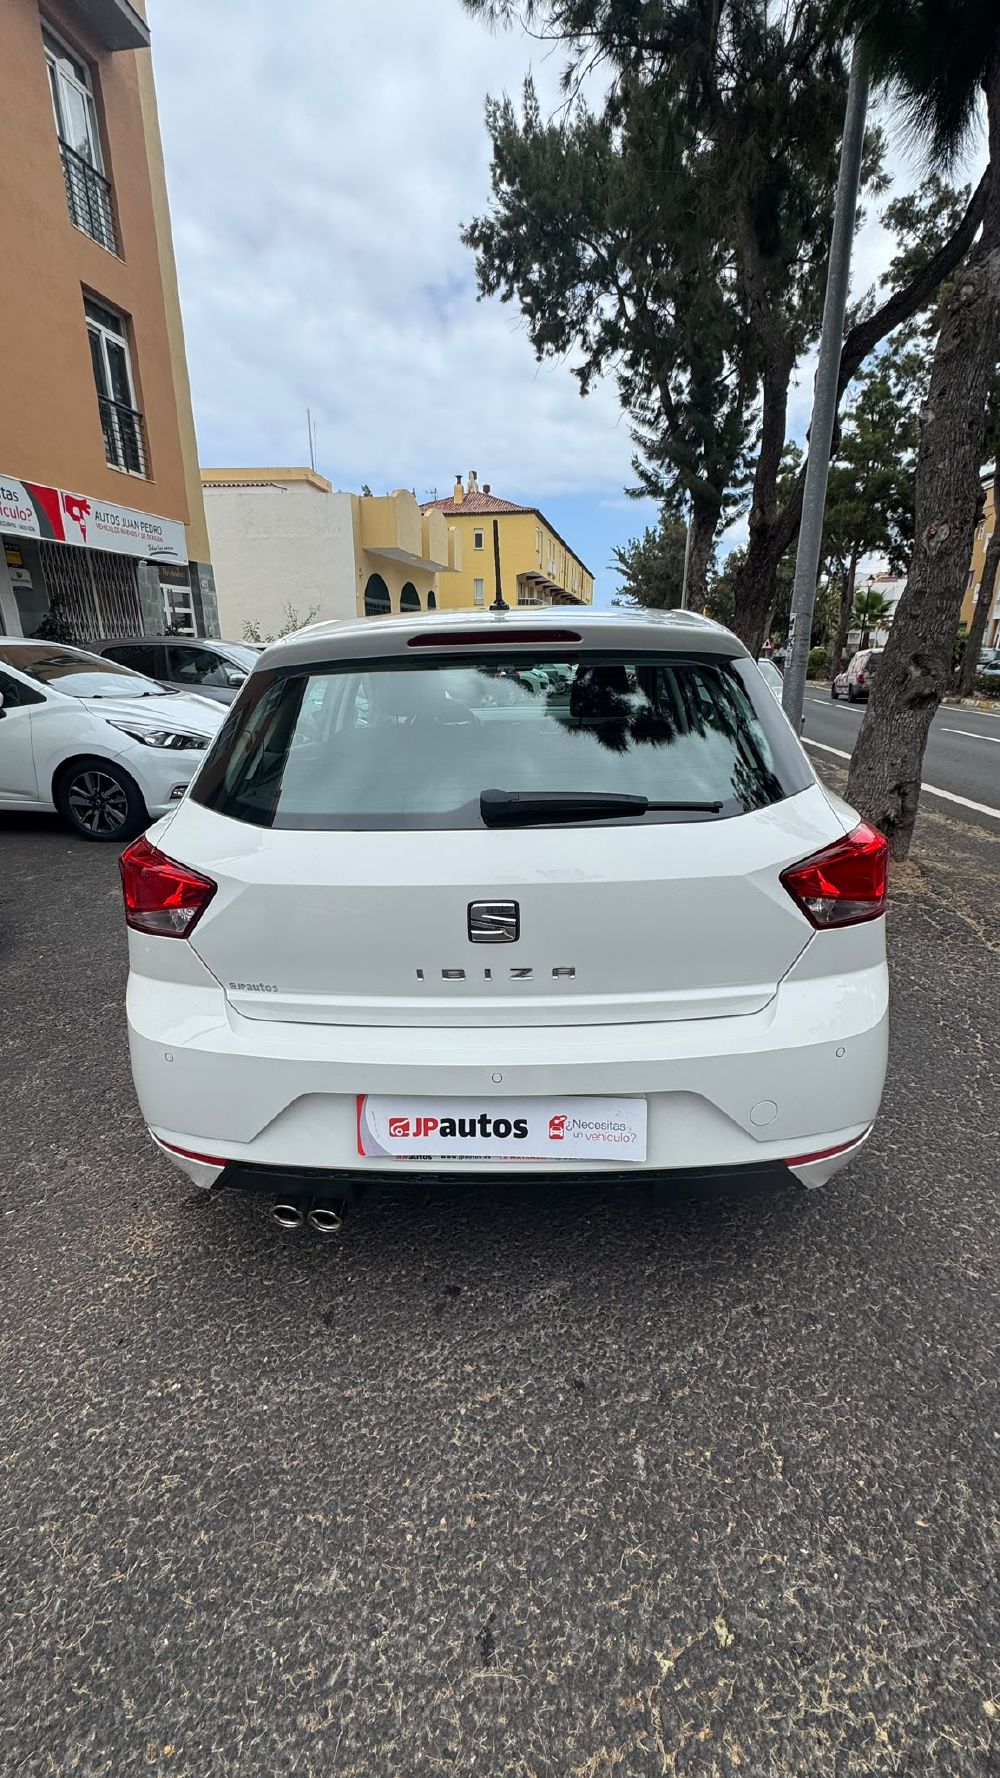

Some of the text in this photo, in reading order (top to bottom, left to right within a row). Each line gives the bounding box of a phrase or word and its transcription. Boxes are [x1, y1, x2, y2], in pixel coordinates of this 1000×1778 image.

[0, 487, 19, 502] tas
[95, 511, 163, 536] AUTOS JUAN PEDRO
[416, 967, 576, 981] IBIZA
[412, 1113, 529, 1139] JPautos
[566, 1119, 626, 1132] ¿Necesitas
[573, 1131, 637, 1144] un vehículo?
